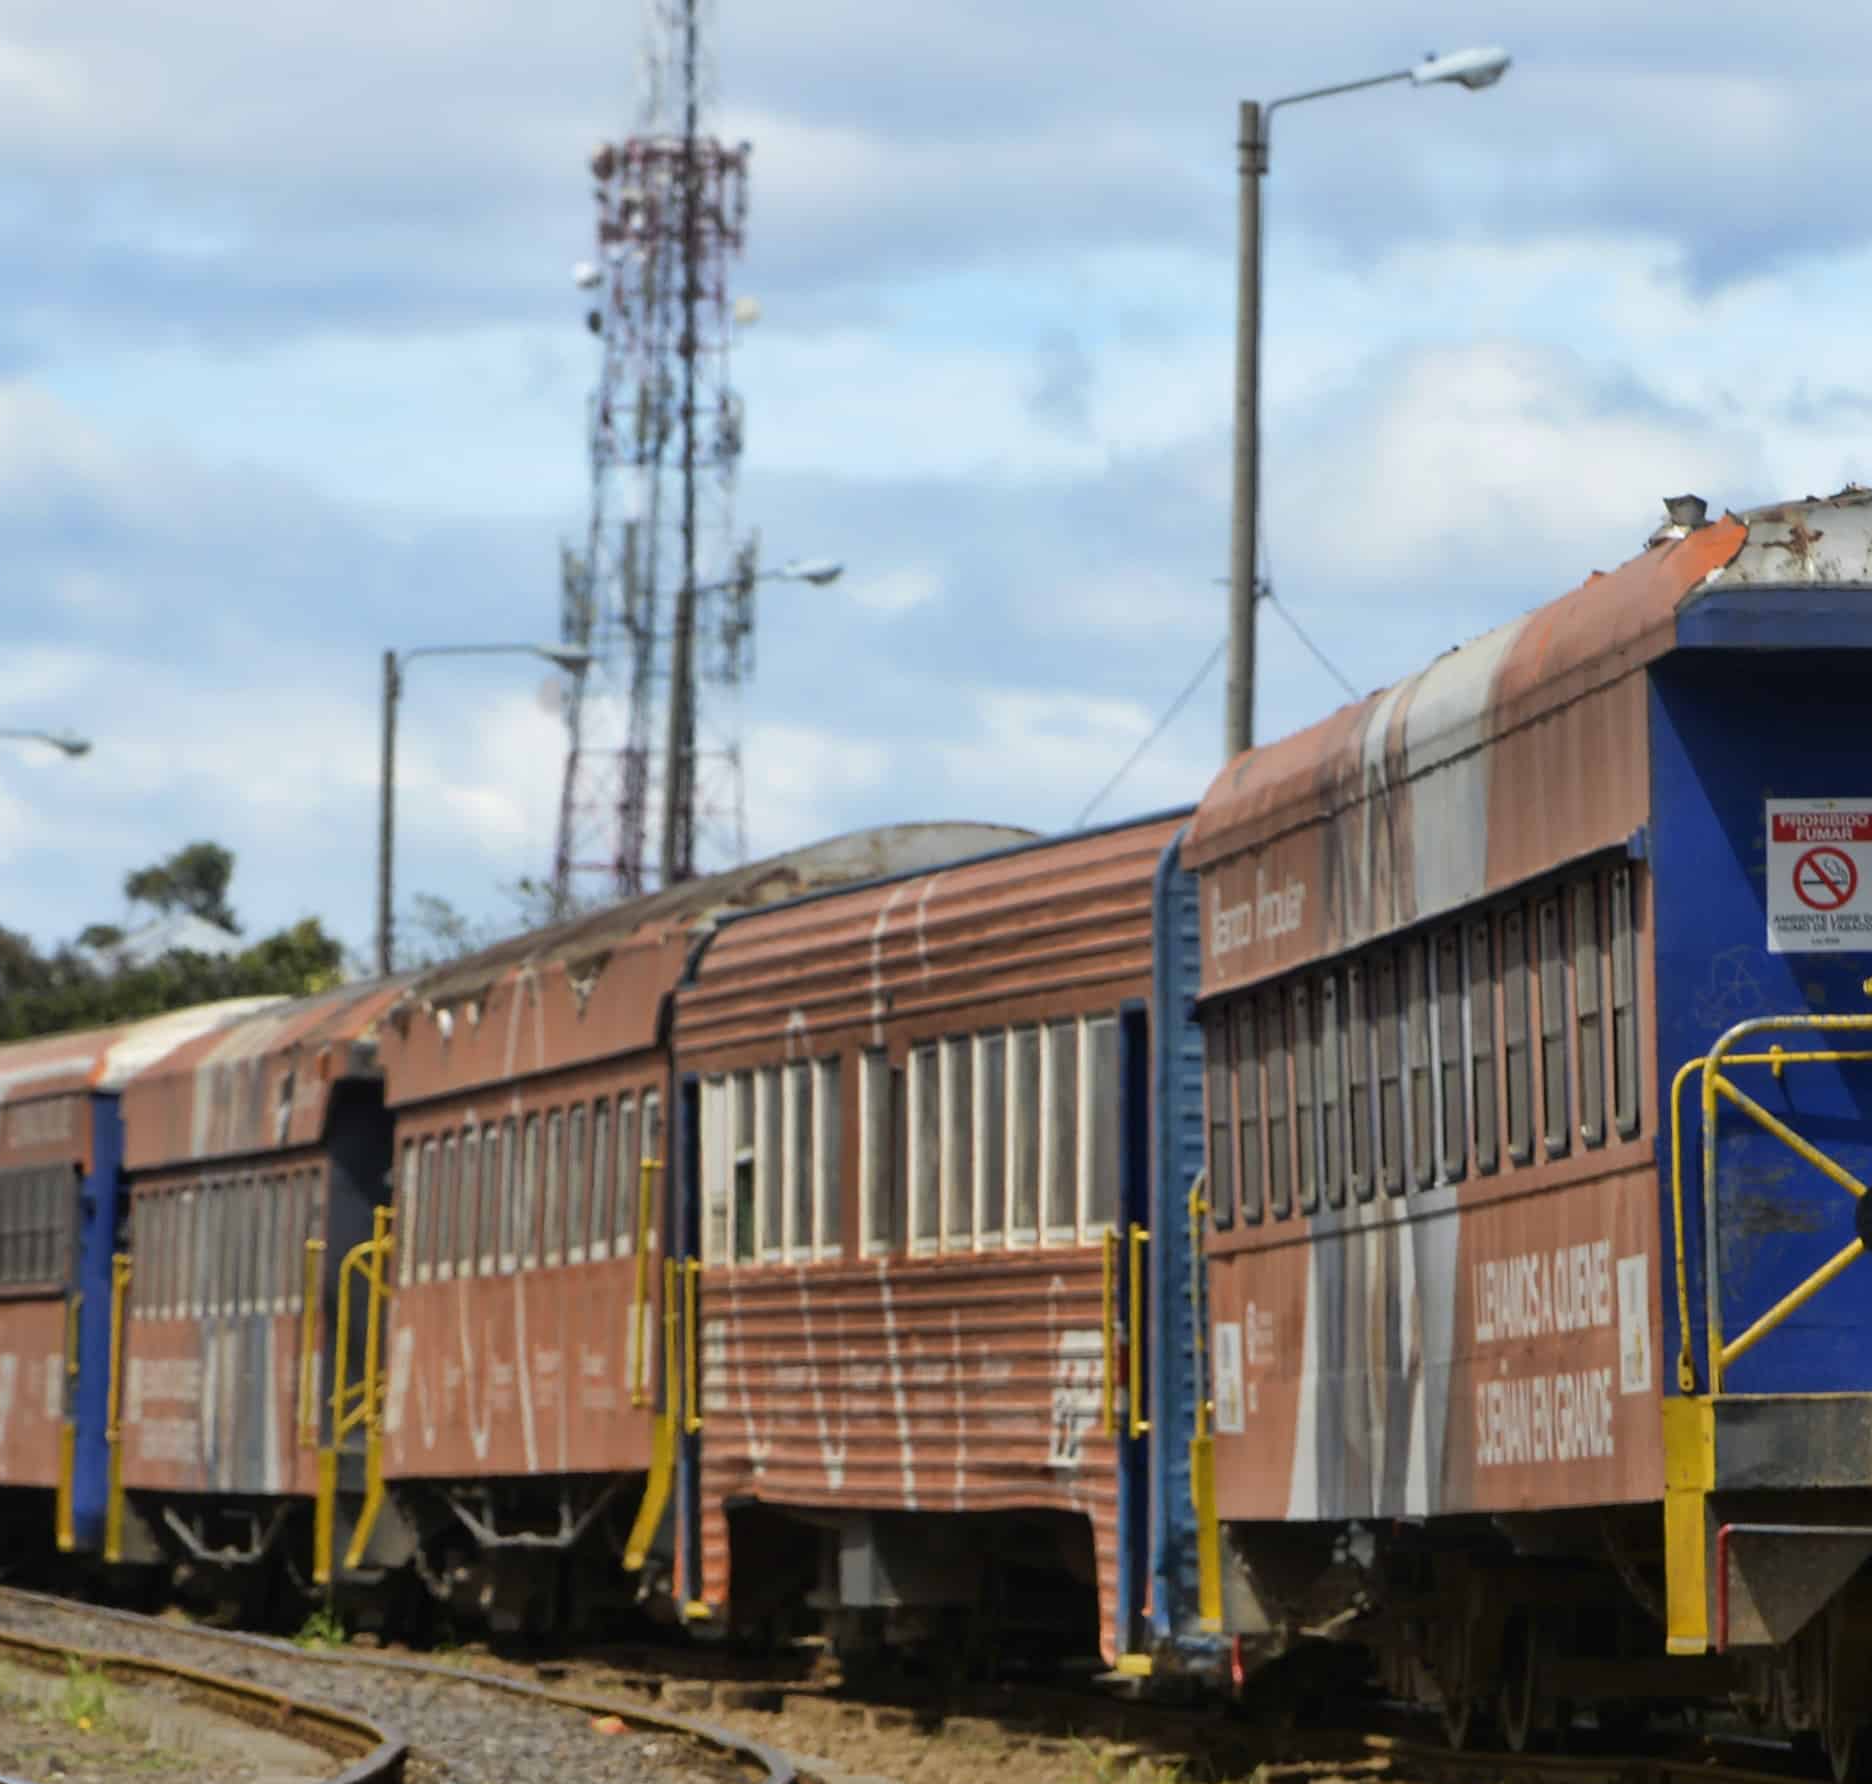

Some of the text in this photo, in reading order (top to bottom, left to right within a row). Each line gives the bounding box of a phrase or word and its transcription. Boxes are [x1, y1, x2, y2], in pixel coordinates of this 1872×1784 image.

[1779, 814, 1869, 828] PROHIBIDO
[1796, 827, 1853, 841] FUMAR
[1472, 1250, 1539, 1342] LLEVAMOS
[1541, 1249, 1555, 1335] A
[1554, 1238, 1611, 1333] QUIENES
[1532, 1374, 1553, 1462] EN
[1554, 1367, 1615, 1462] GRANDE
